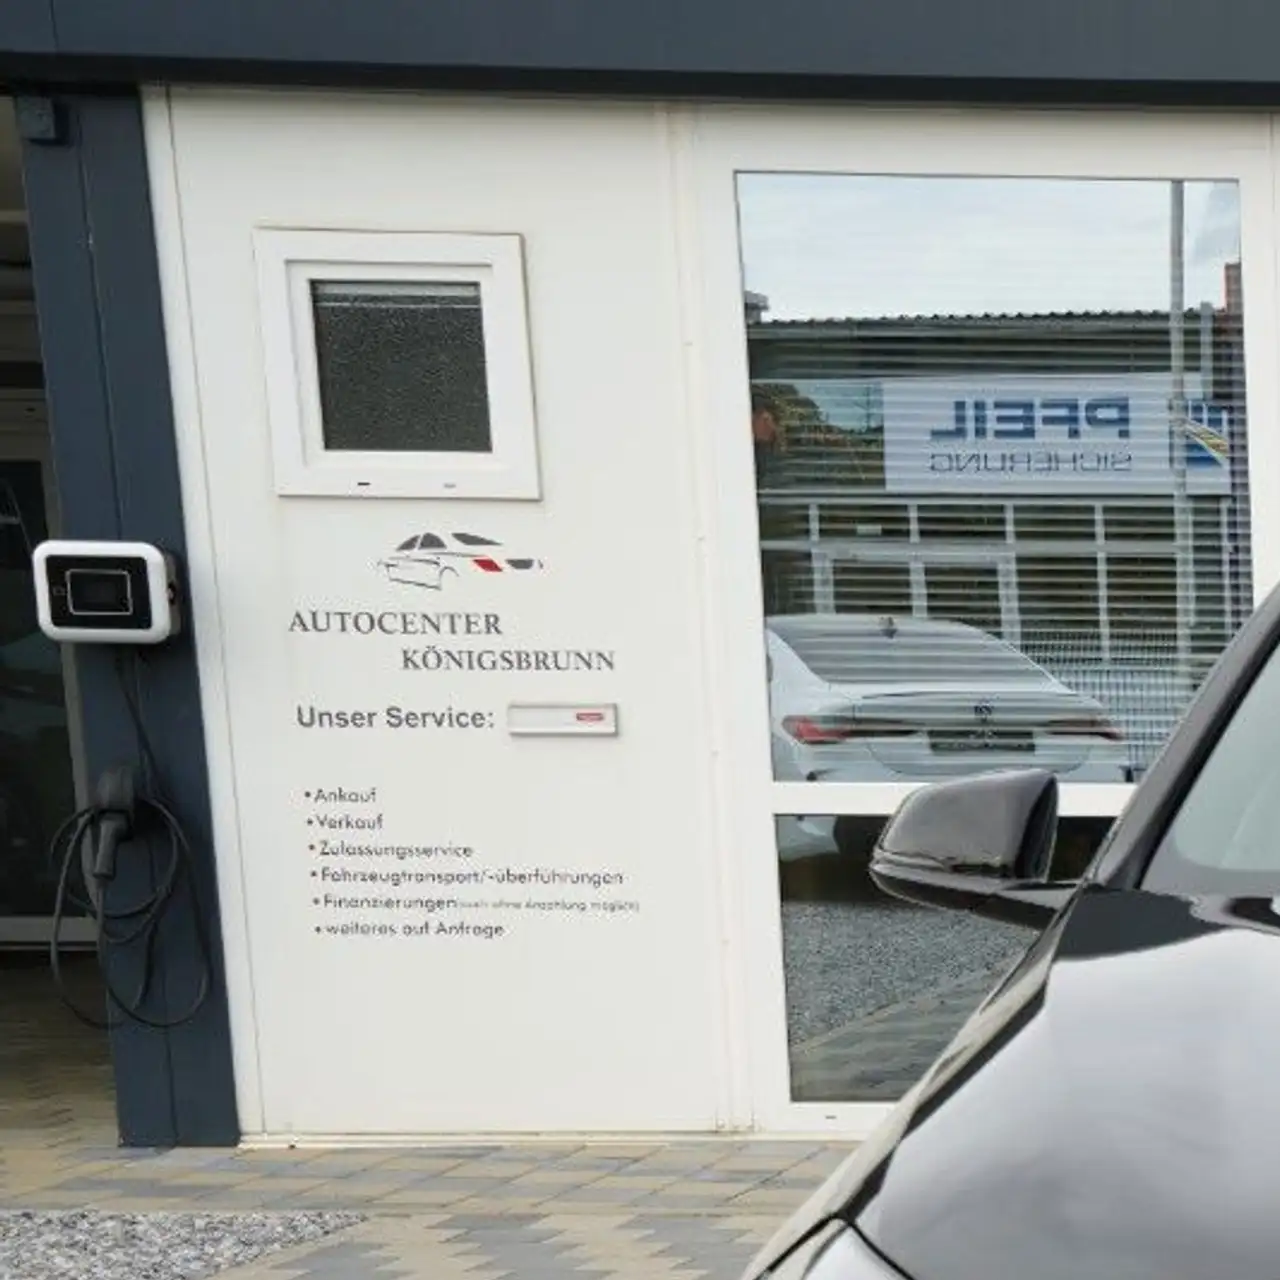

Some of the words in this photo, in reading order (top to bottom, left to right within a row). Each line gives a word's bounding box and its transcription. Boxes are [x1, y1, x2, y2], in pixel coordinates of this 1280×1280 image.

[288, 610, 504, 635] AUTOCENTER
[400, 645, 616, 671] KÖNIGSBRUNN
[297, 706, 378, 729] Unser
[385, 706, 495, 729] Service:
[314, 787, 377, 803] Ankauf
[316, 814, 384, 830] Verkauf
[319, 840, 474, 860] Zulassungsservice
[326, 922, 397, 935] weiteres
[402, 922, 430, 936] auf
